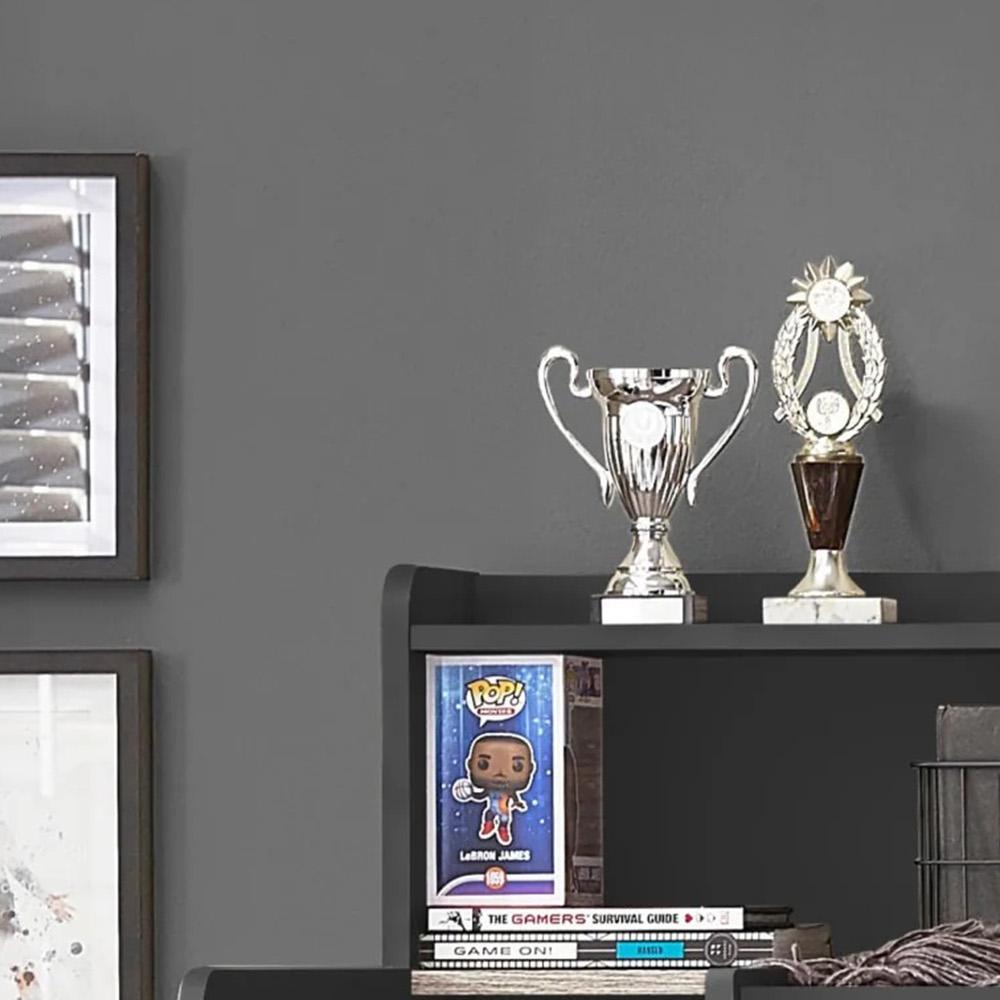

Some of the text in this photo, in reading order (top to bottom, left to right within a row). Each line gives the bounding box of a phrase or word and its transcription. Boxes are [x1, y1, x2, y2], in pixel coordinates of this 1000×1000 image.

[465, 678, 525, 708] POP!
[460, 850, 530, 861] LeBRON JAMES
[488, 914, 508, 924] THE
[592, 913, 644, 924] SURVIVAL
[647, 913, 679, 924] GUIDE
[454, 946, 553, 956] GAME ON!
